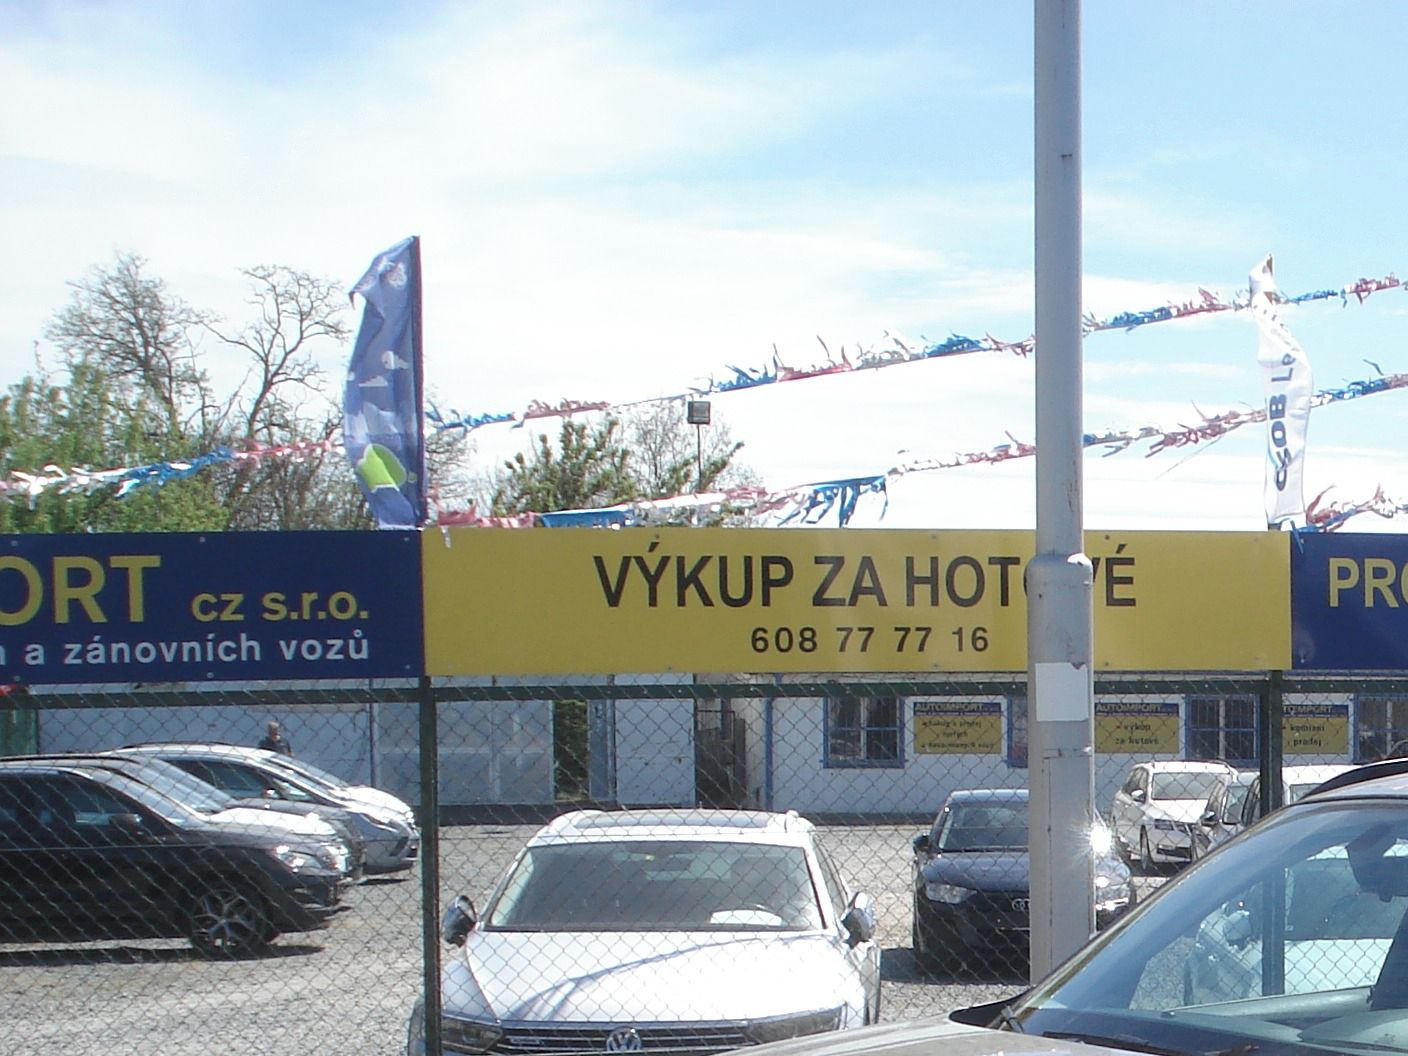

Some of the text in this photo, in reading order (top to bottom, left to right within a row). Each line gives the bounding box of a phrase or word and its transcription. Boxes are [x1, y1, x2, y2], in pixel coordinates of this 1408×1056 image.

[592, 541, 1137, 609] VÝKUP ZA HOTÉ
[190, 592, 245, 623] cz
[260, 590, 370, 621] s.r.o.
[24, 642, 45, 665] a
[63, 633, 262, 666] zánovních
[279, 629, 370, 661] vozů
[750, 625, 989, 654] 608 77 77 16
